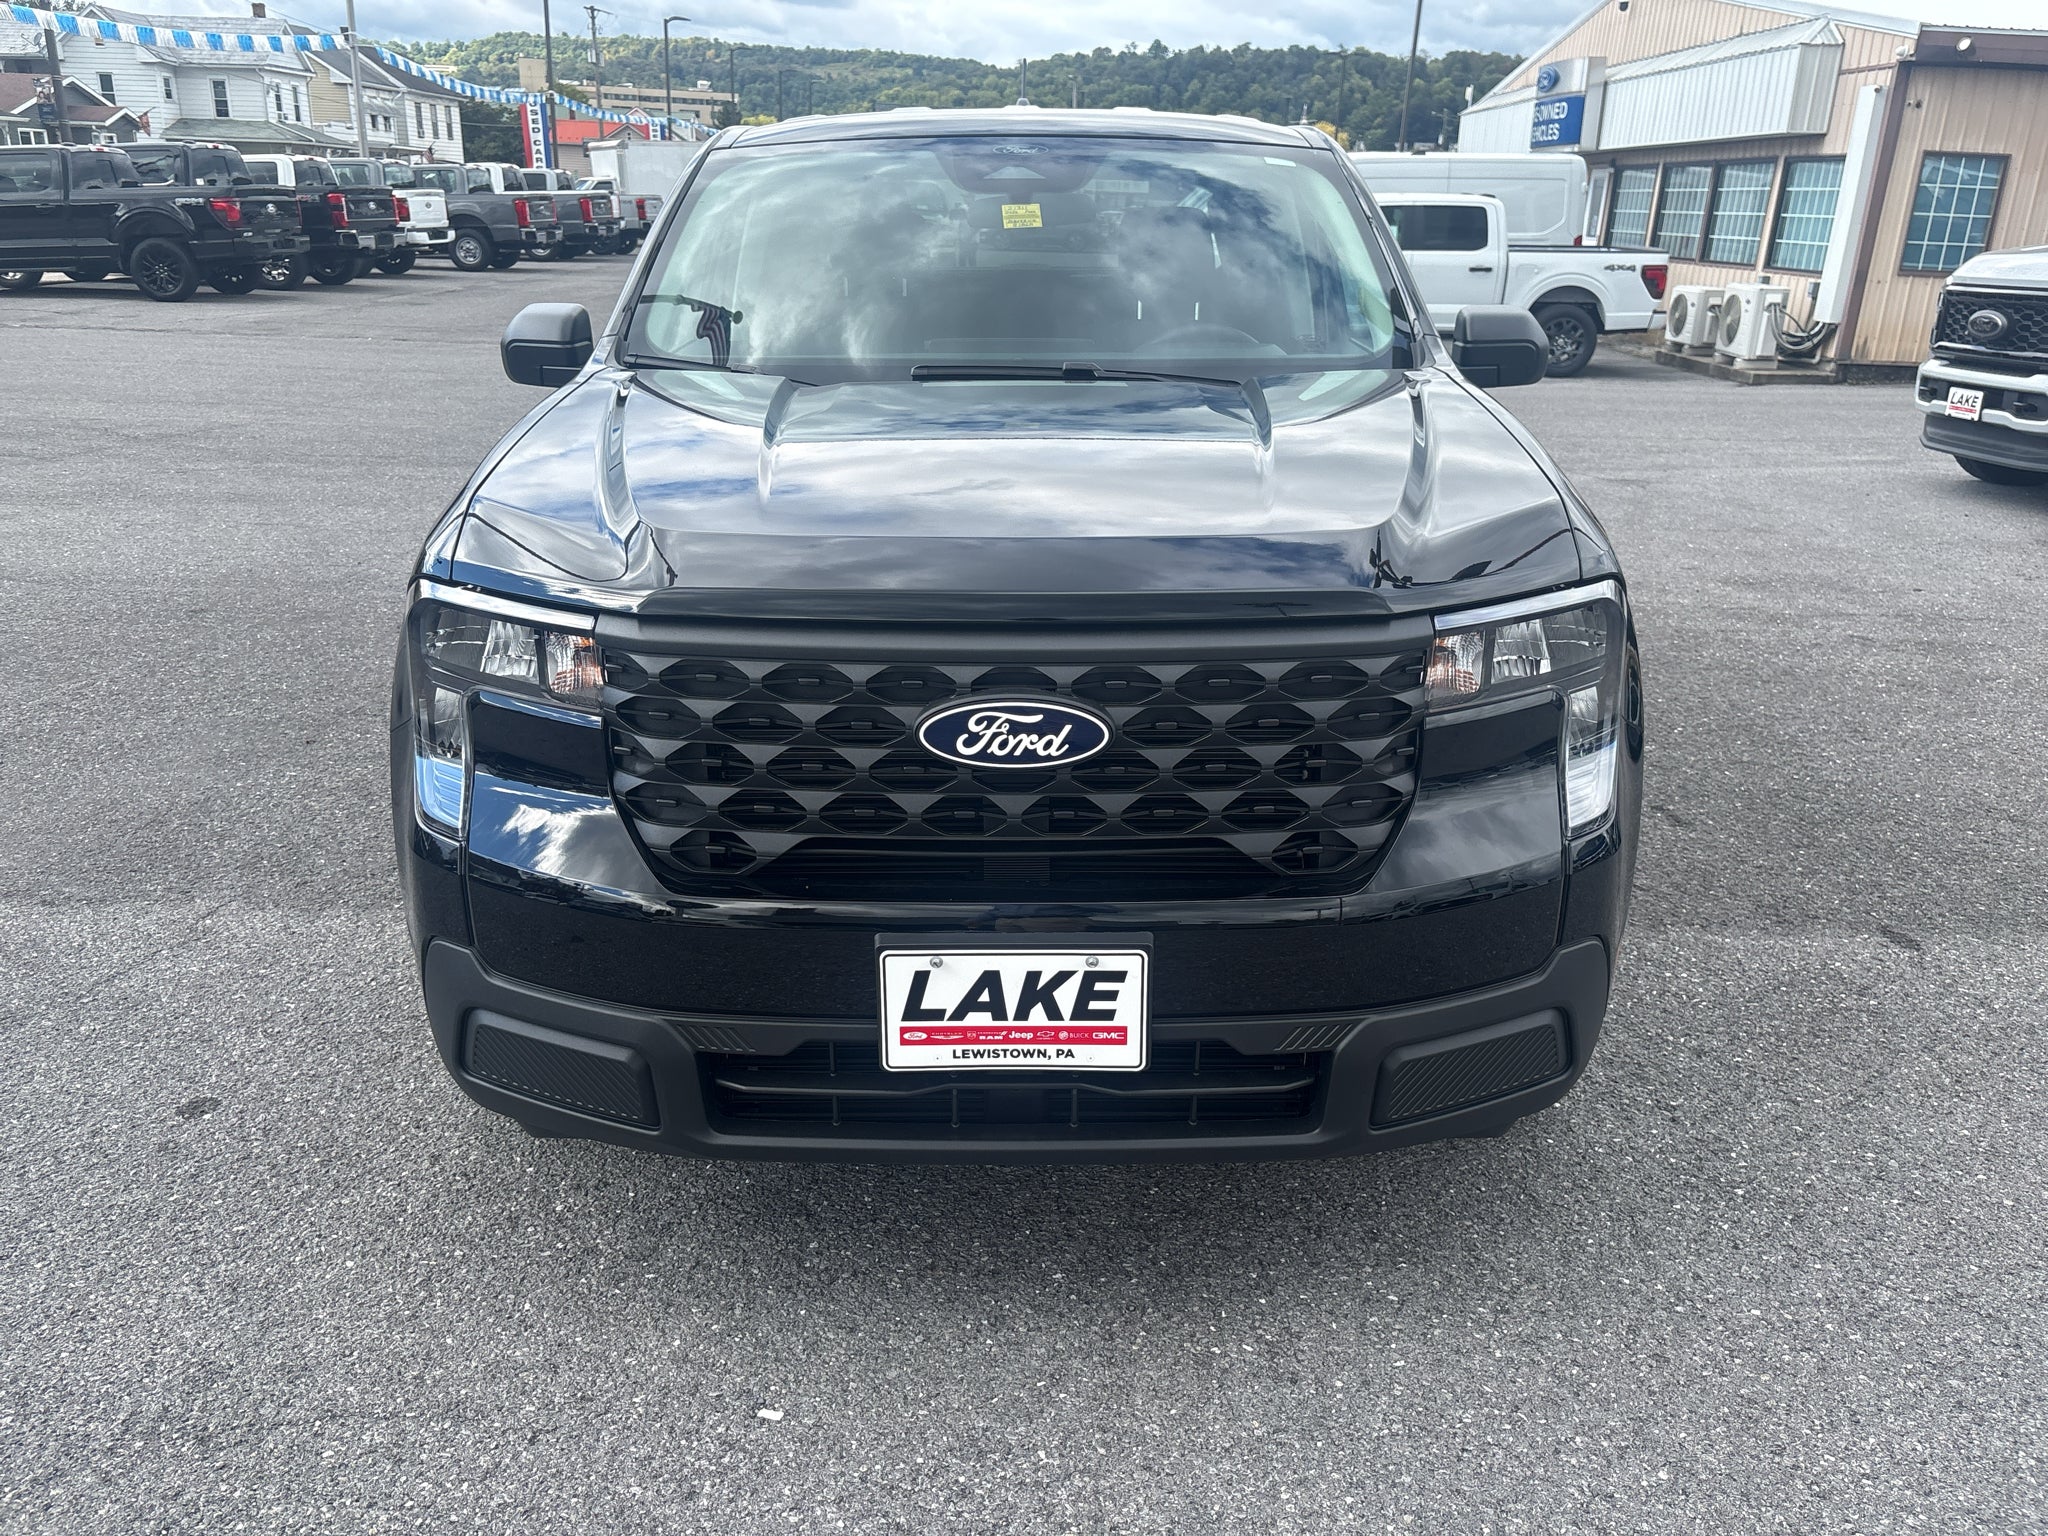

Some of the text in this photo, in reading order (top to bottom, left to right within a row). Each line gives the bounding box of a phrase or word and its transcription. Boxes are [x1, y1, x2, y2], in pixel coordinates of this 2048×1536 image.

[1950, 391, 1979, 408] LAKE
[956, 711, 1072, 757] Ford
[901, 970, 1128, 1022] LAKE
[1009, 1030, 1034, 1040] Jeep
[1092, 1032, 1125, 1040] GMC
[952, 1048, 1075, 1061] LEWISTOWN, PA
